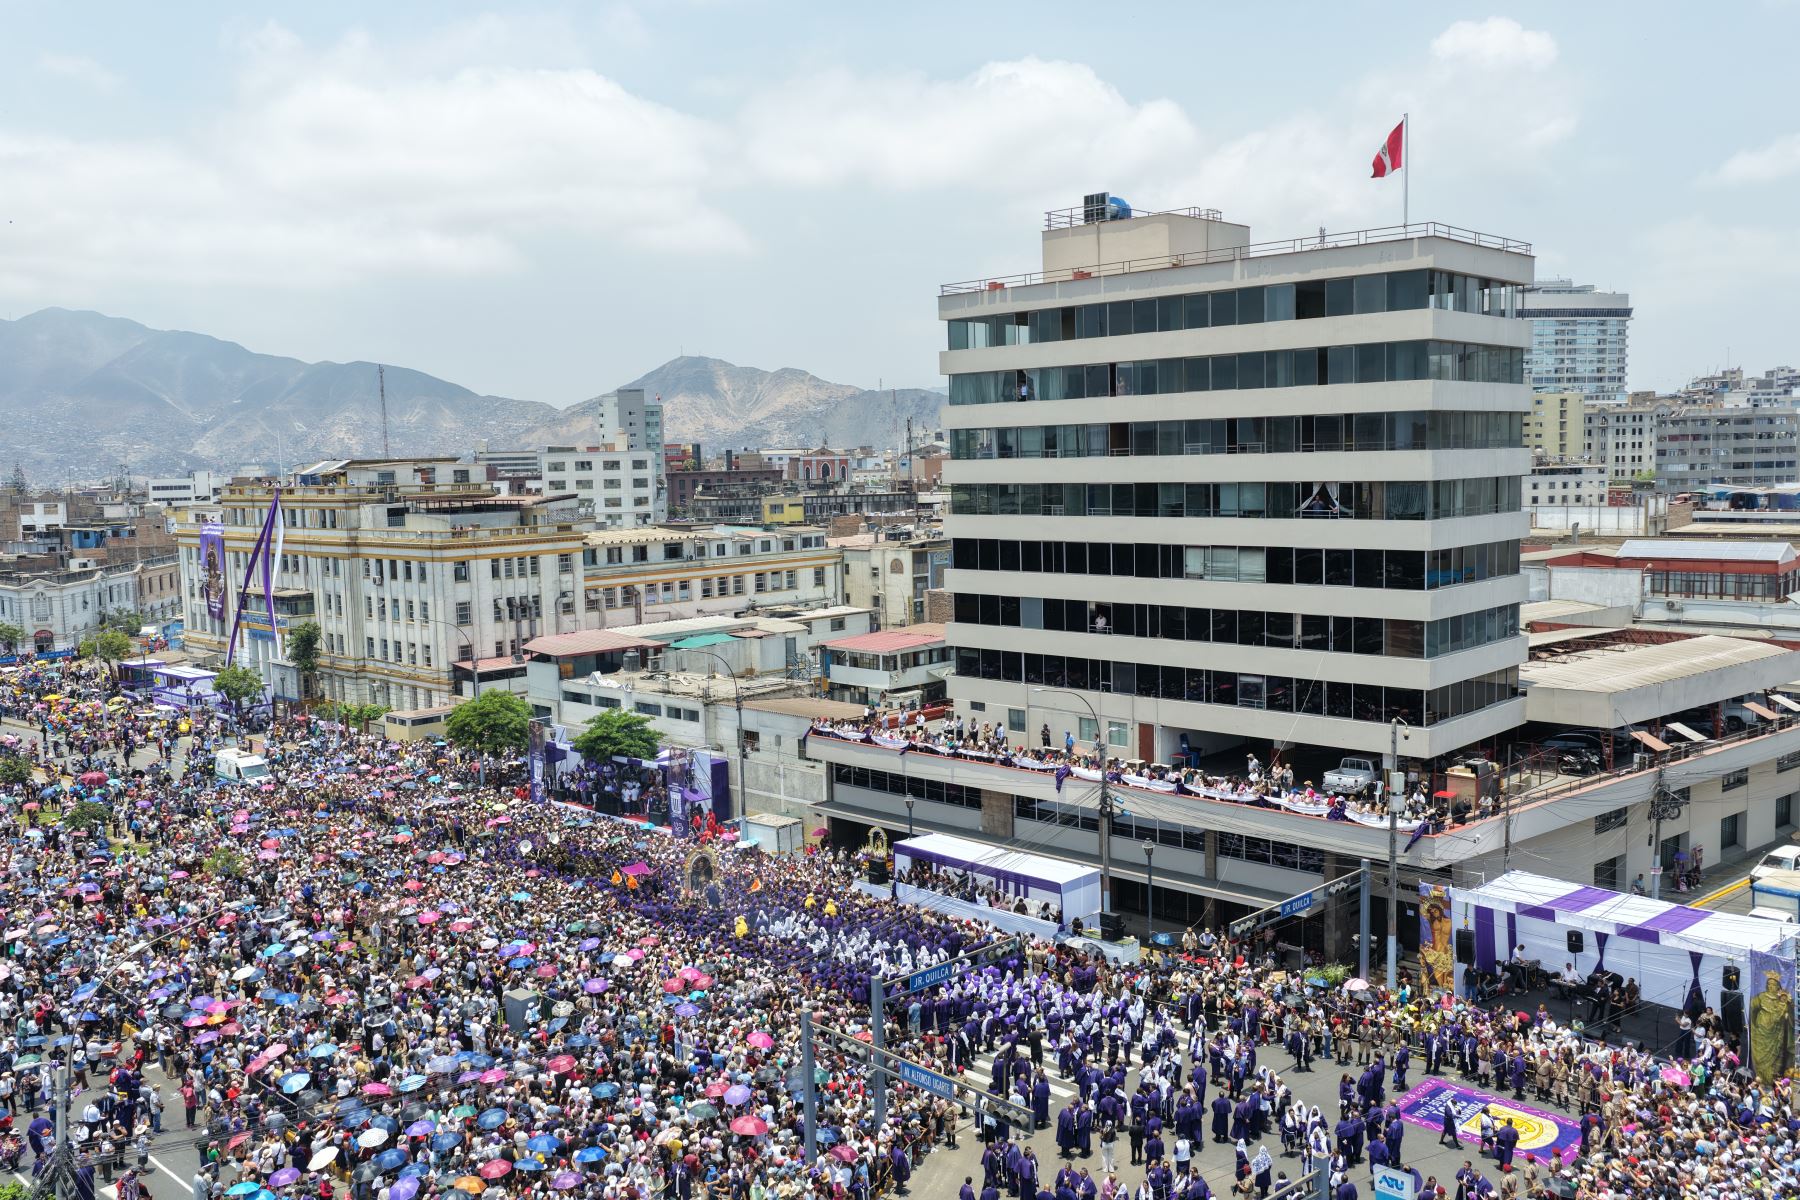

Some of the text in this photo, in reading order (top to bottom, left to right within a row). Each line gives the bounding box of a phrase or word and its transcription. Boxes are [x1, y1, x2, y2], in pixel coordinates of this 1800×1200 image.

[1292, 897, 1310, 911] QUILCA
[913, 967, 949, 988] JR. QUILCA
[911, 1069, 932, 1088] ALFONSO
[932, 1077, 950, 1095] UGARTE
[1379, 1174, 1405, 1191] ATU
